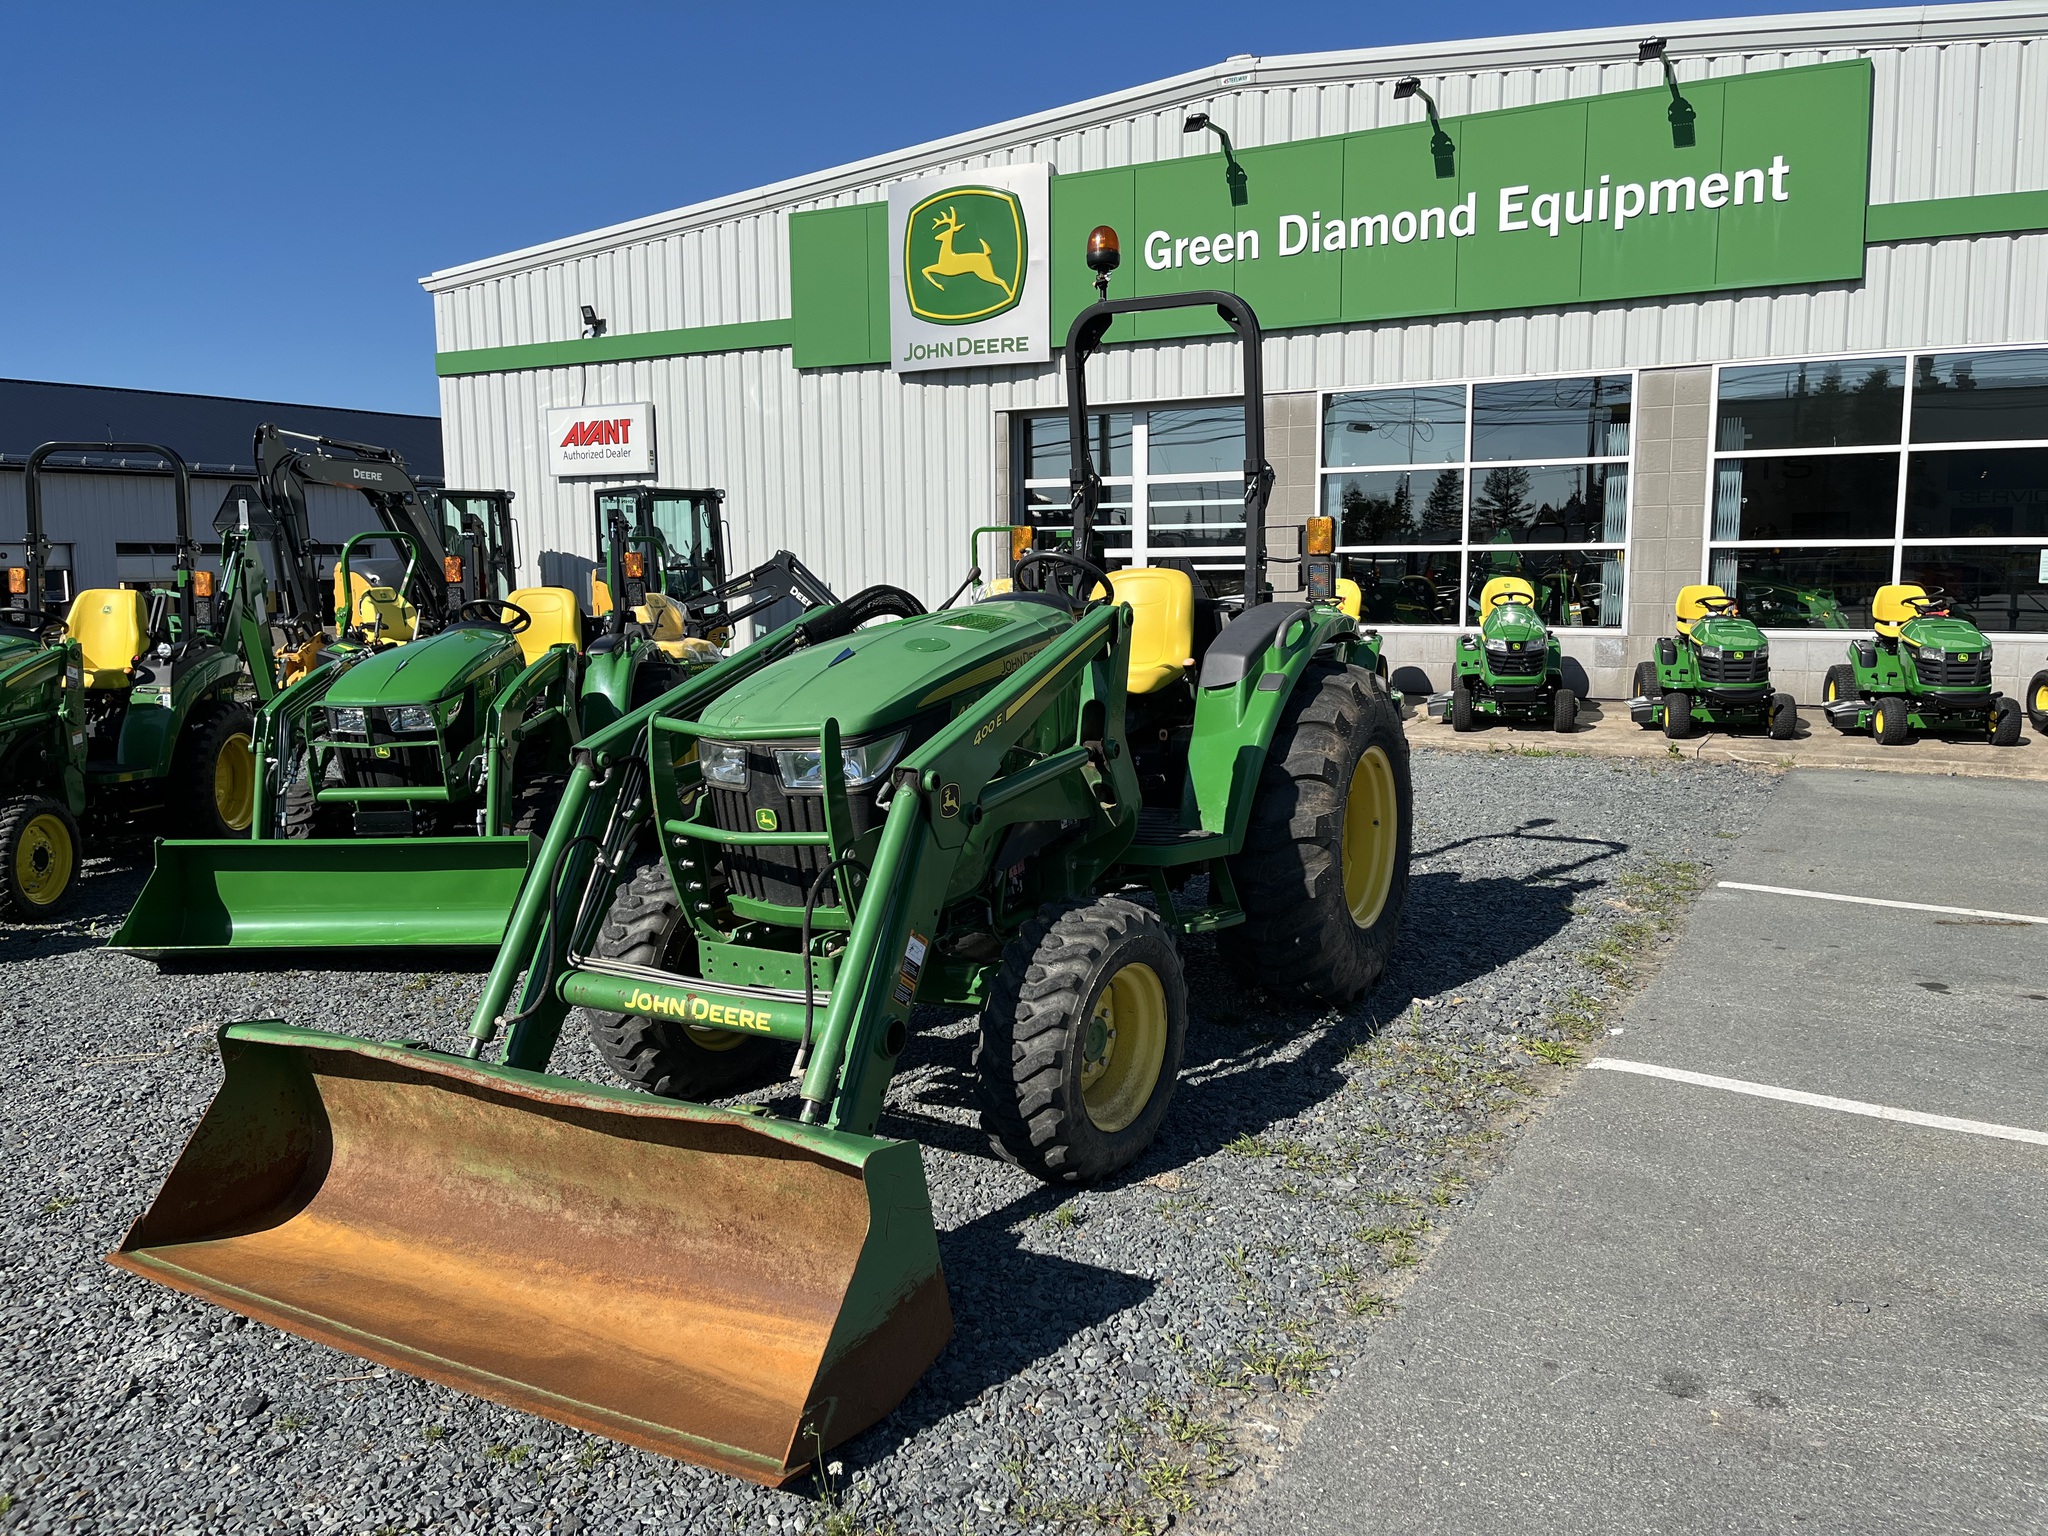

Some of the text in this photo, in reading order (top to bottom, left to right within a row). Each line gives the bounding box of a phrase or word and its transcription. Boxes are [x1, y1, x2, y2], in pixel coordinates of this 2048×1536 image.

[1144, 154, 1790, 272] Green Diamond Equipment
[903, 336, 1029, 362] JOHN DEERE
[560, 418, 631, 448] AVANT
[563, 448, 632, 461] Authorized Dealer
[353, 468, 383, 481] DEERE
[624, 988, 772, 1032] JOHN DEERE
